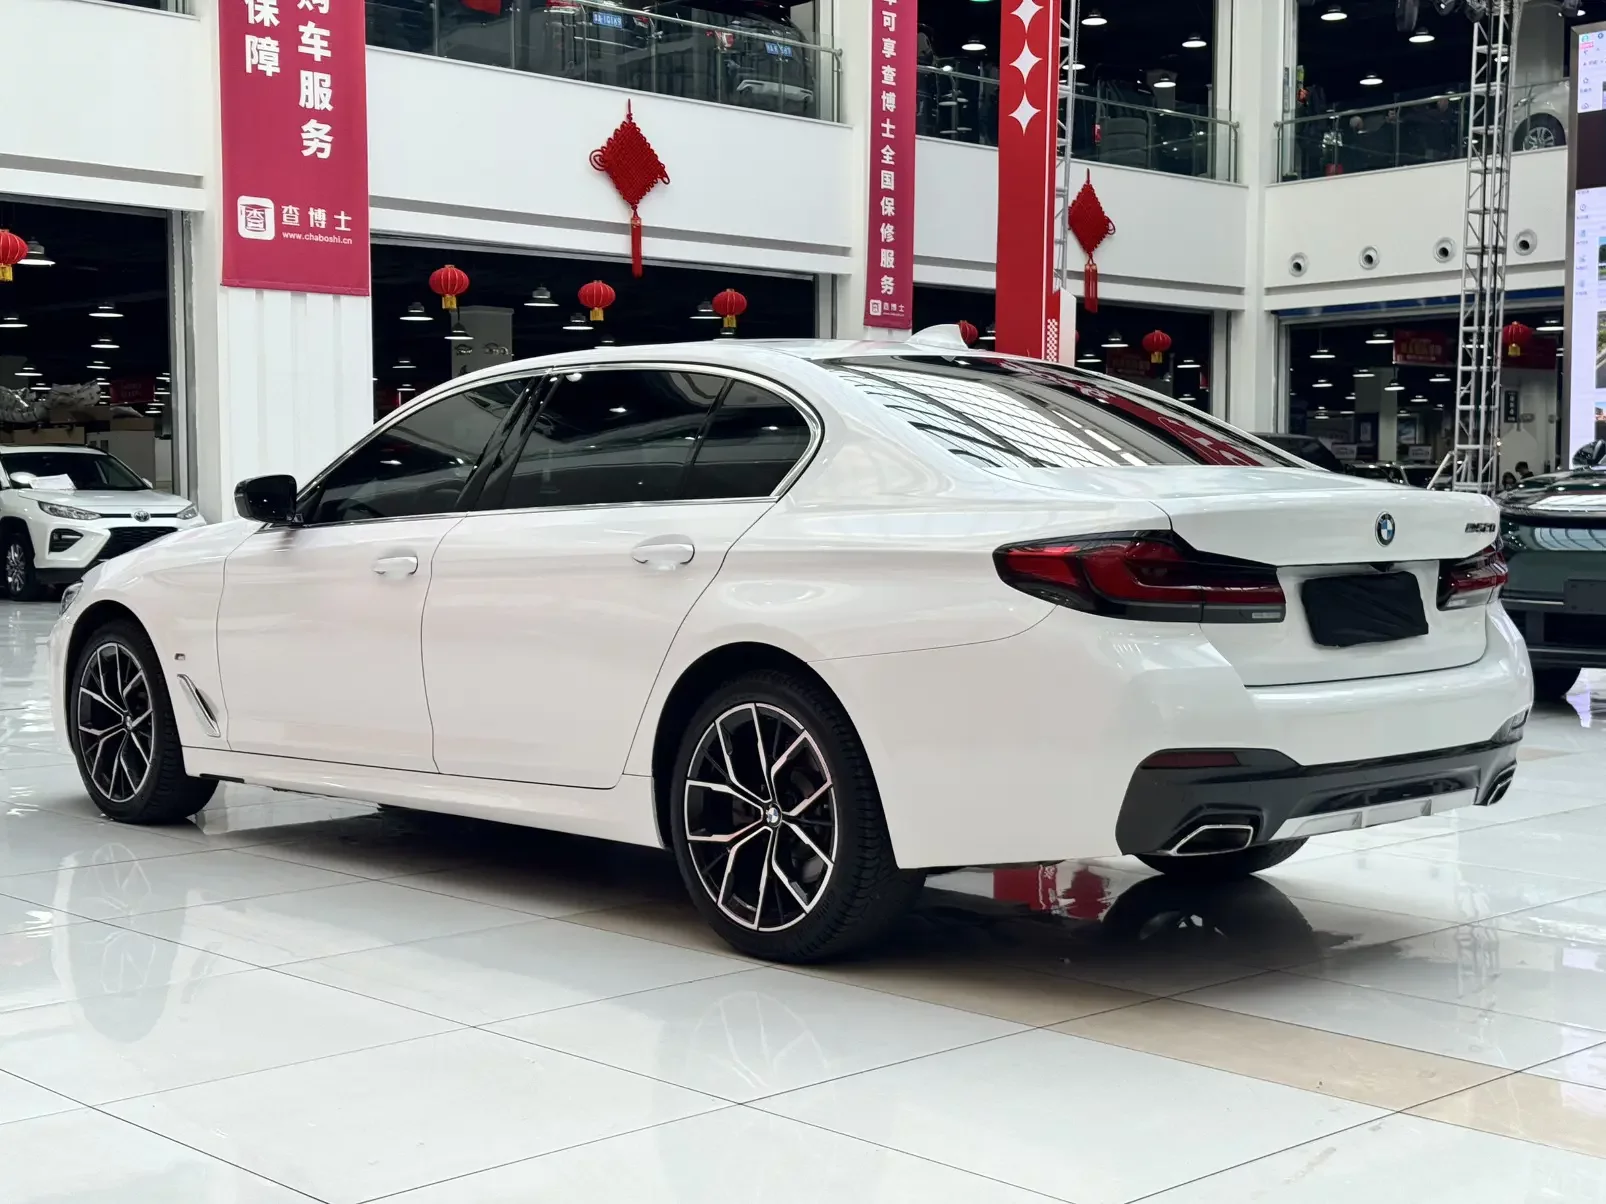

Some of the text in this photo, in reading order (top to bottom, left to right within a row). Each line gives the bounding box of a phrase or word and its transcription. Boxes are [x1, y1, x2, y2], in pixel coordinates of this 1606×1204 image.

[245, 0, 280, 77] 保障
[880, 0, 898, 295] 可享查博士全国保修服务
[280, 205, 352, 232] 查博士
[282, 231, 353, 245] www.chaboshi.cn
